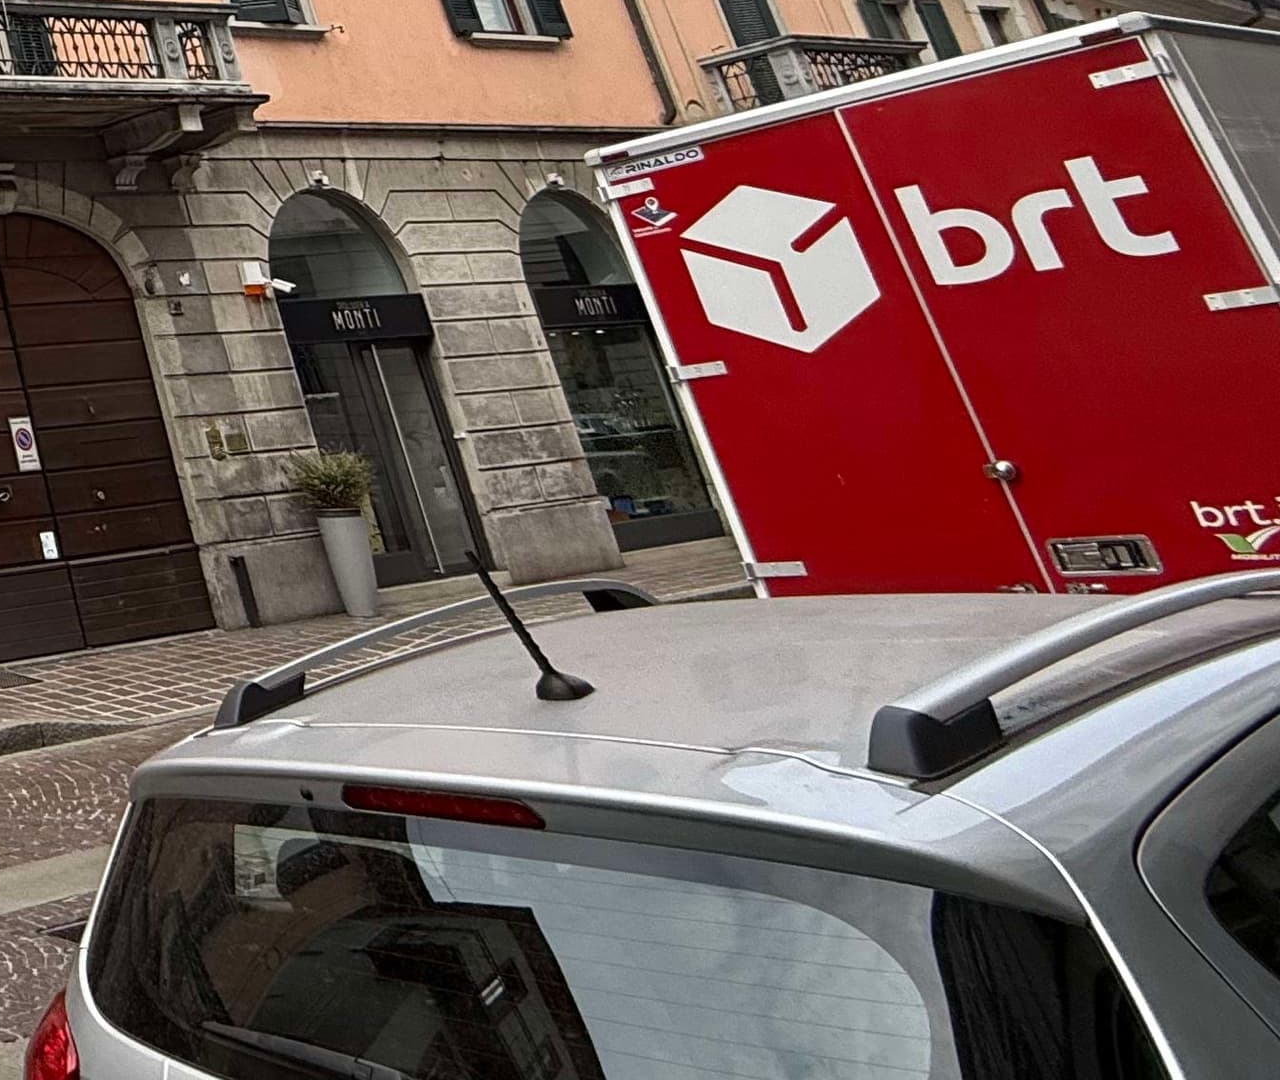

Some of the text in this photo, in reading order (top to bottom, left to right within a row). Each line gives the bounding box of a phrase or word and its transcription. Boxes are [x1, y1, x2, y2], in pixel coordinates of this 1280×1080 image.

[625, 149, 700, 174] RINALDO
[894, 156, 1181, 285] brt
[574, 296, 618, 316] MONTI
[332, 308, 381, 331] MONTI
[1189, 496, 1280, 528] brt.
